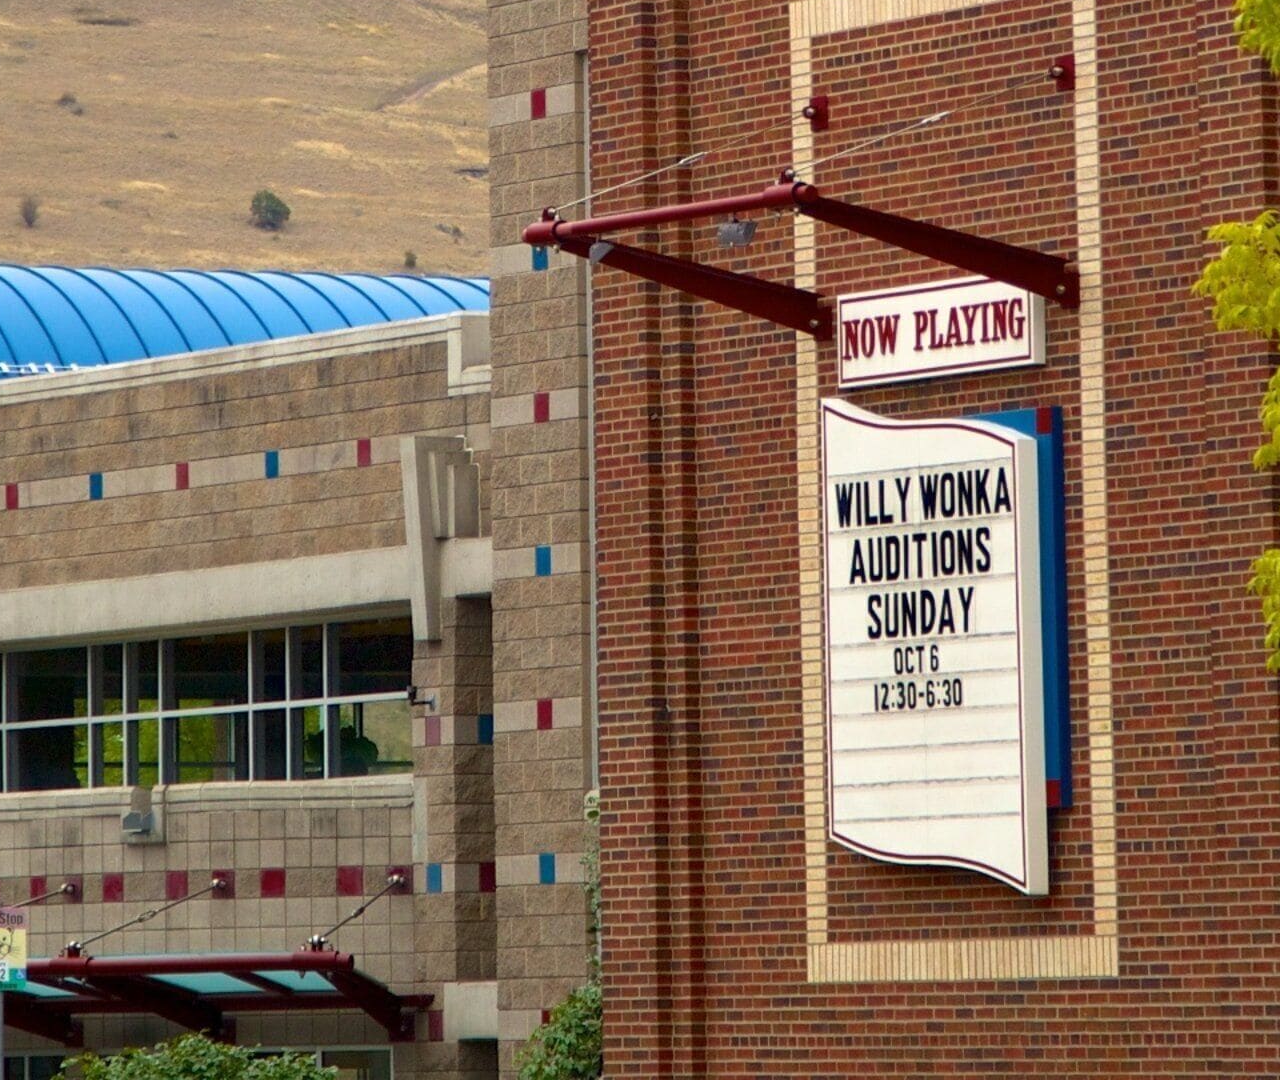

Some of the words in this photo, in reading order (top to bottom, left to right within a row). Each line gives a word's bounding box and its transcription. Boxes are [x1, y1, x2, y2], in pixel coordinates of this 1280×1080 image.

[841, 313, 900, 361] NOW
[913, 298, 1026, 351] PLAYING
[835, 477, 911, 528] WILLY
[919, 467, 1012, 520] WONKA
[849, 527, 991, 584] AUDITIONS
[867, 587, 974, 639] SUNDAY
[893, 645, 925, 674] OCT
[930, 644, 939, 672] 6
[873, 678, 963, 712] 12:30-6:30
[0, 913, 24, 926] Stop
